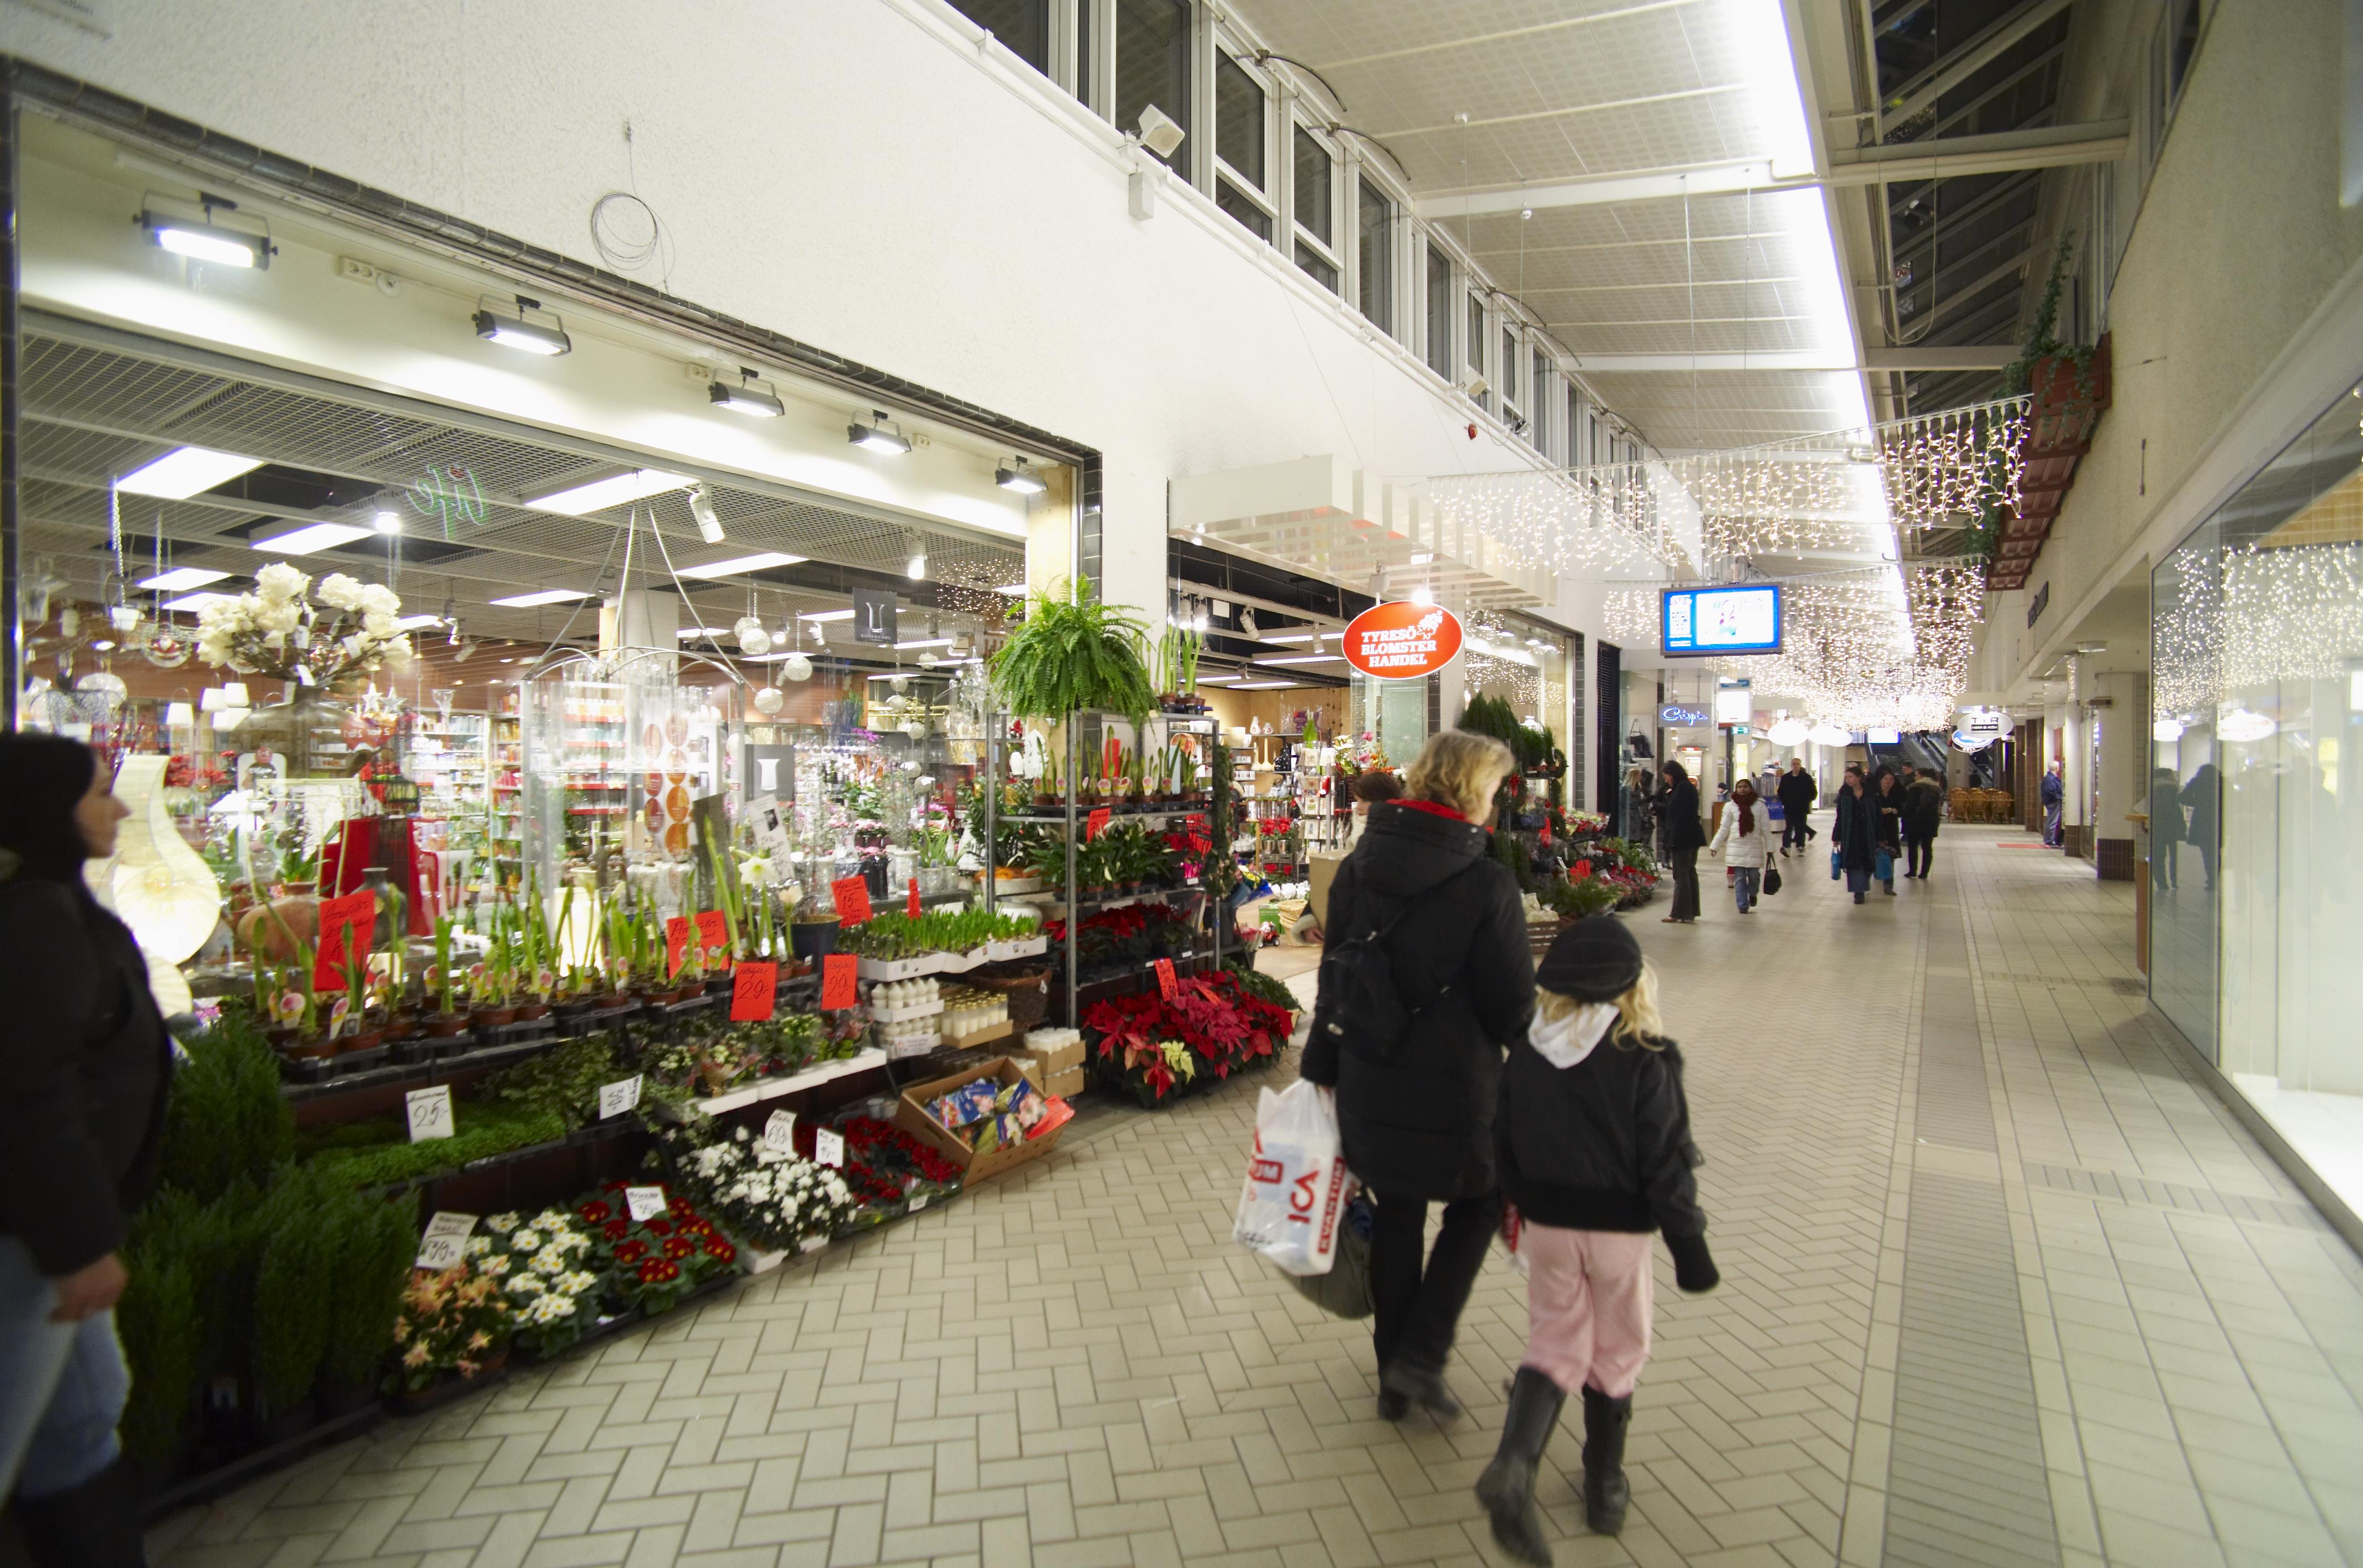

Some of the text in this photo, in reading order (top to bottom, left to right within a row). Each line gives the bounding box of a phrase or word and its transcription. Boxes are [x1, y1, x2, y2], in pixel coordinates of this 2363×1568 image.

[1361, 626, 1417, 642] TYRESÖ
[1361, 640, 1436, 655] BLOMSTER
[1369, 654, 1427, 667] HANDEL
[1286, 1170, 1320, 1224] ICA
